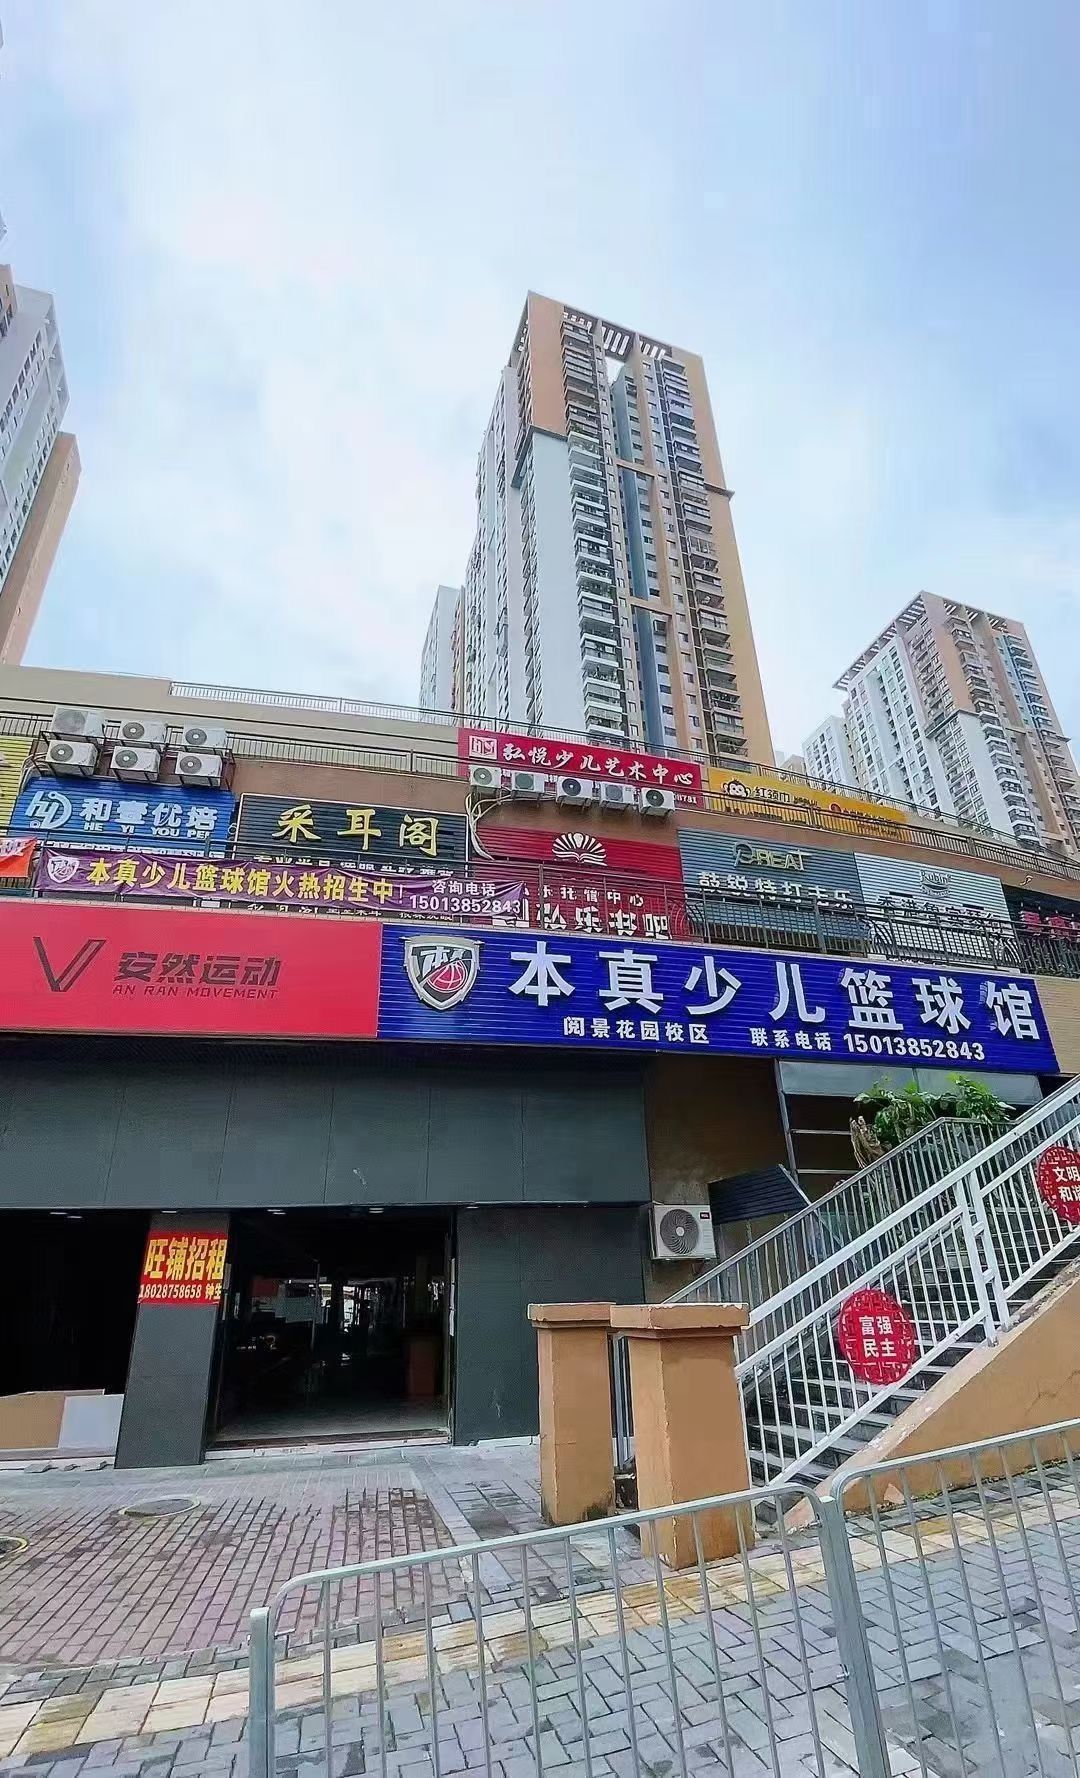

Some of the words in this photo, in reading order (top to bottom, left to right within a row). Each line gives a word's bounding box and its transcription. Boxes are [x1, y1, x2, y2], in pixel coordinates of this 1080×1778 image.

[501, 742, 693, 785] 弘悦少儿艺术中心
[84, 822, 103, 832] HE
[121, 824, 135, 834] YI
[151, 827, 179, 838] YOU
[271, 804, 438, 857] 采耳阁
[431, 880, 496, 897] 咨询电话
[409, 894, 521, 915] 15013852843
[113, 952, 283, 987] 安然运动
[112, 985, 135, 996] AN
[144, 985, 175, 997] RAN
[186, 986, 279, 1000] MOVEMENT
[508, 941, 1041, 1041] 本真少儿篮球馆
[563, 1016, 710, 1044] 阅景花园校区
[750, 1027, 832, 1051] 联系电话
[843, 1033, 985, 1061] 15013852843
[1052, 1166, 1080, 1183] 文明
[143, 1236, 228, 1280] 旺铺招租
[138, 1283, 202, 1300] 18028758658
[858, 1315, 894, 1336] 富强
[863, 1340, 897, 1358] 民主
